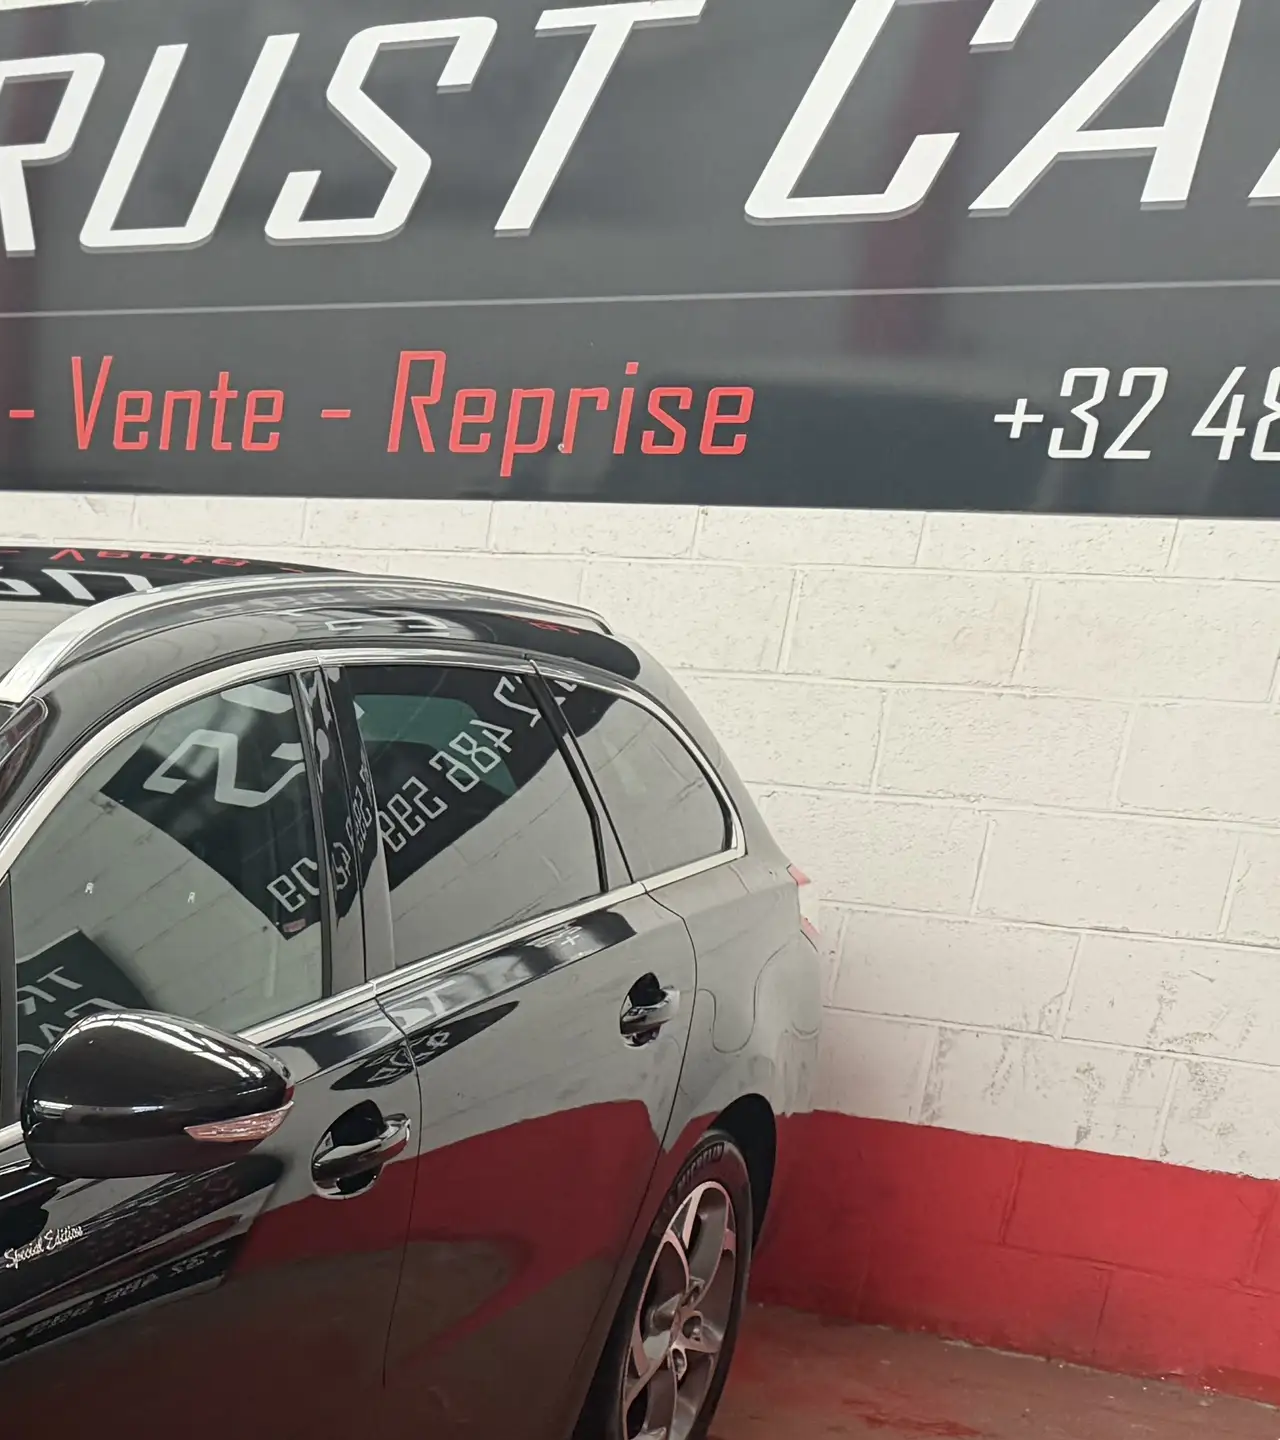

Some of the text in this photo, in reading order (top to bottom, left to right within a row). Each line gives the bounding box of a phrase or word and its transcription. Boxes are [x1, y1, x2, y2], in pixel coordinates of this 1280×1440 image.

[743, 0, 1280, 222] CA
[8, 408, 35, 420] -
[70, 355, 285, 451] Vente
[320, 408, 352, 419] -
[386, 350, 755, 478] Reprise
[993, 366, 1169, 460] +32
[3, 1225, 84, 1269] Special Edition
